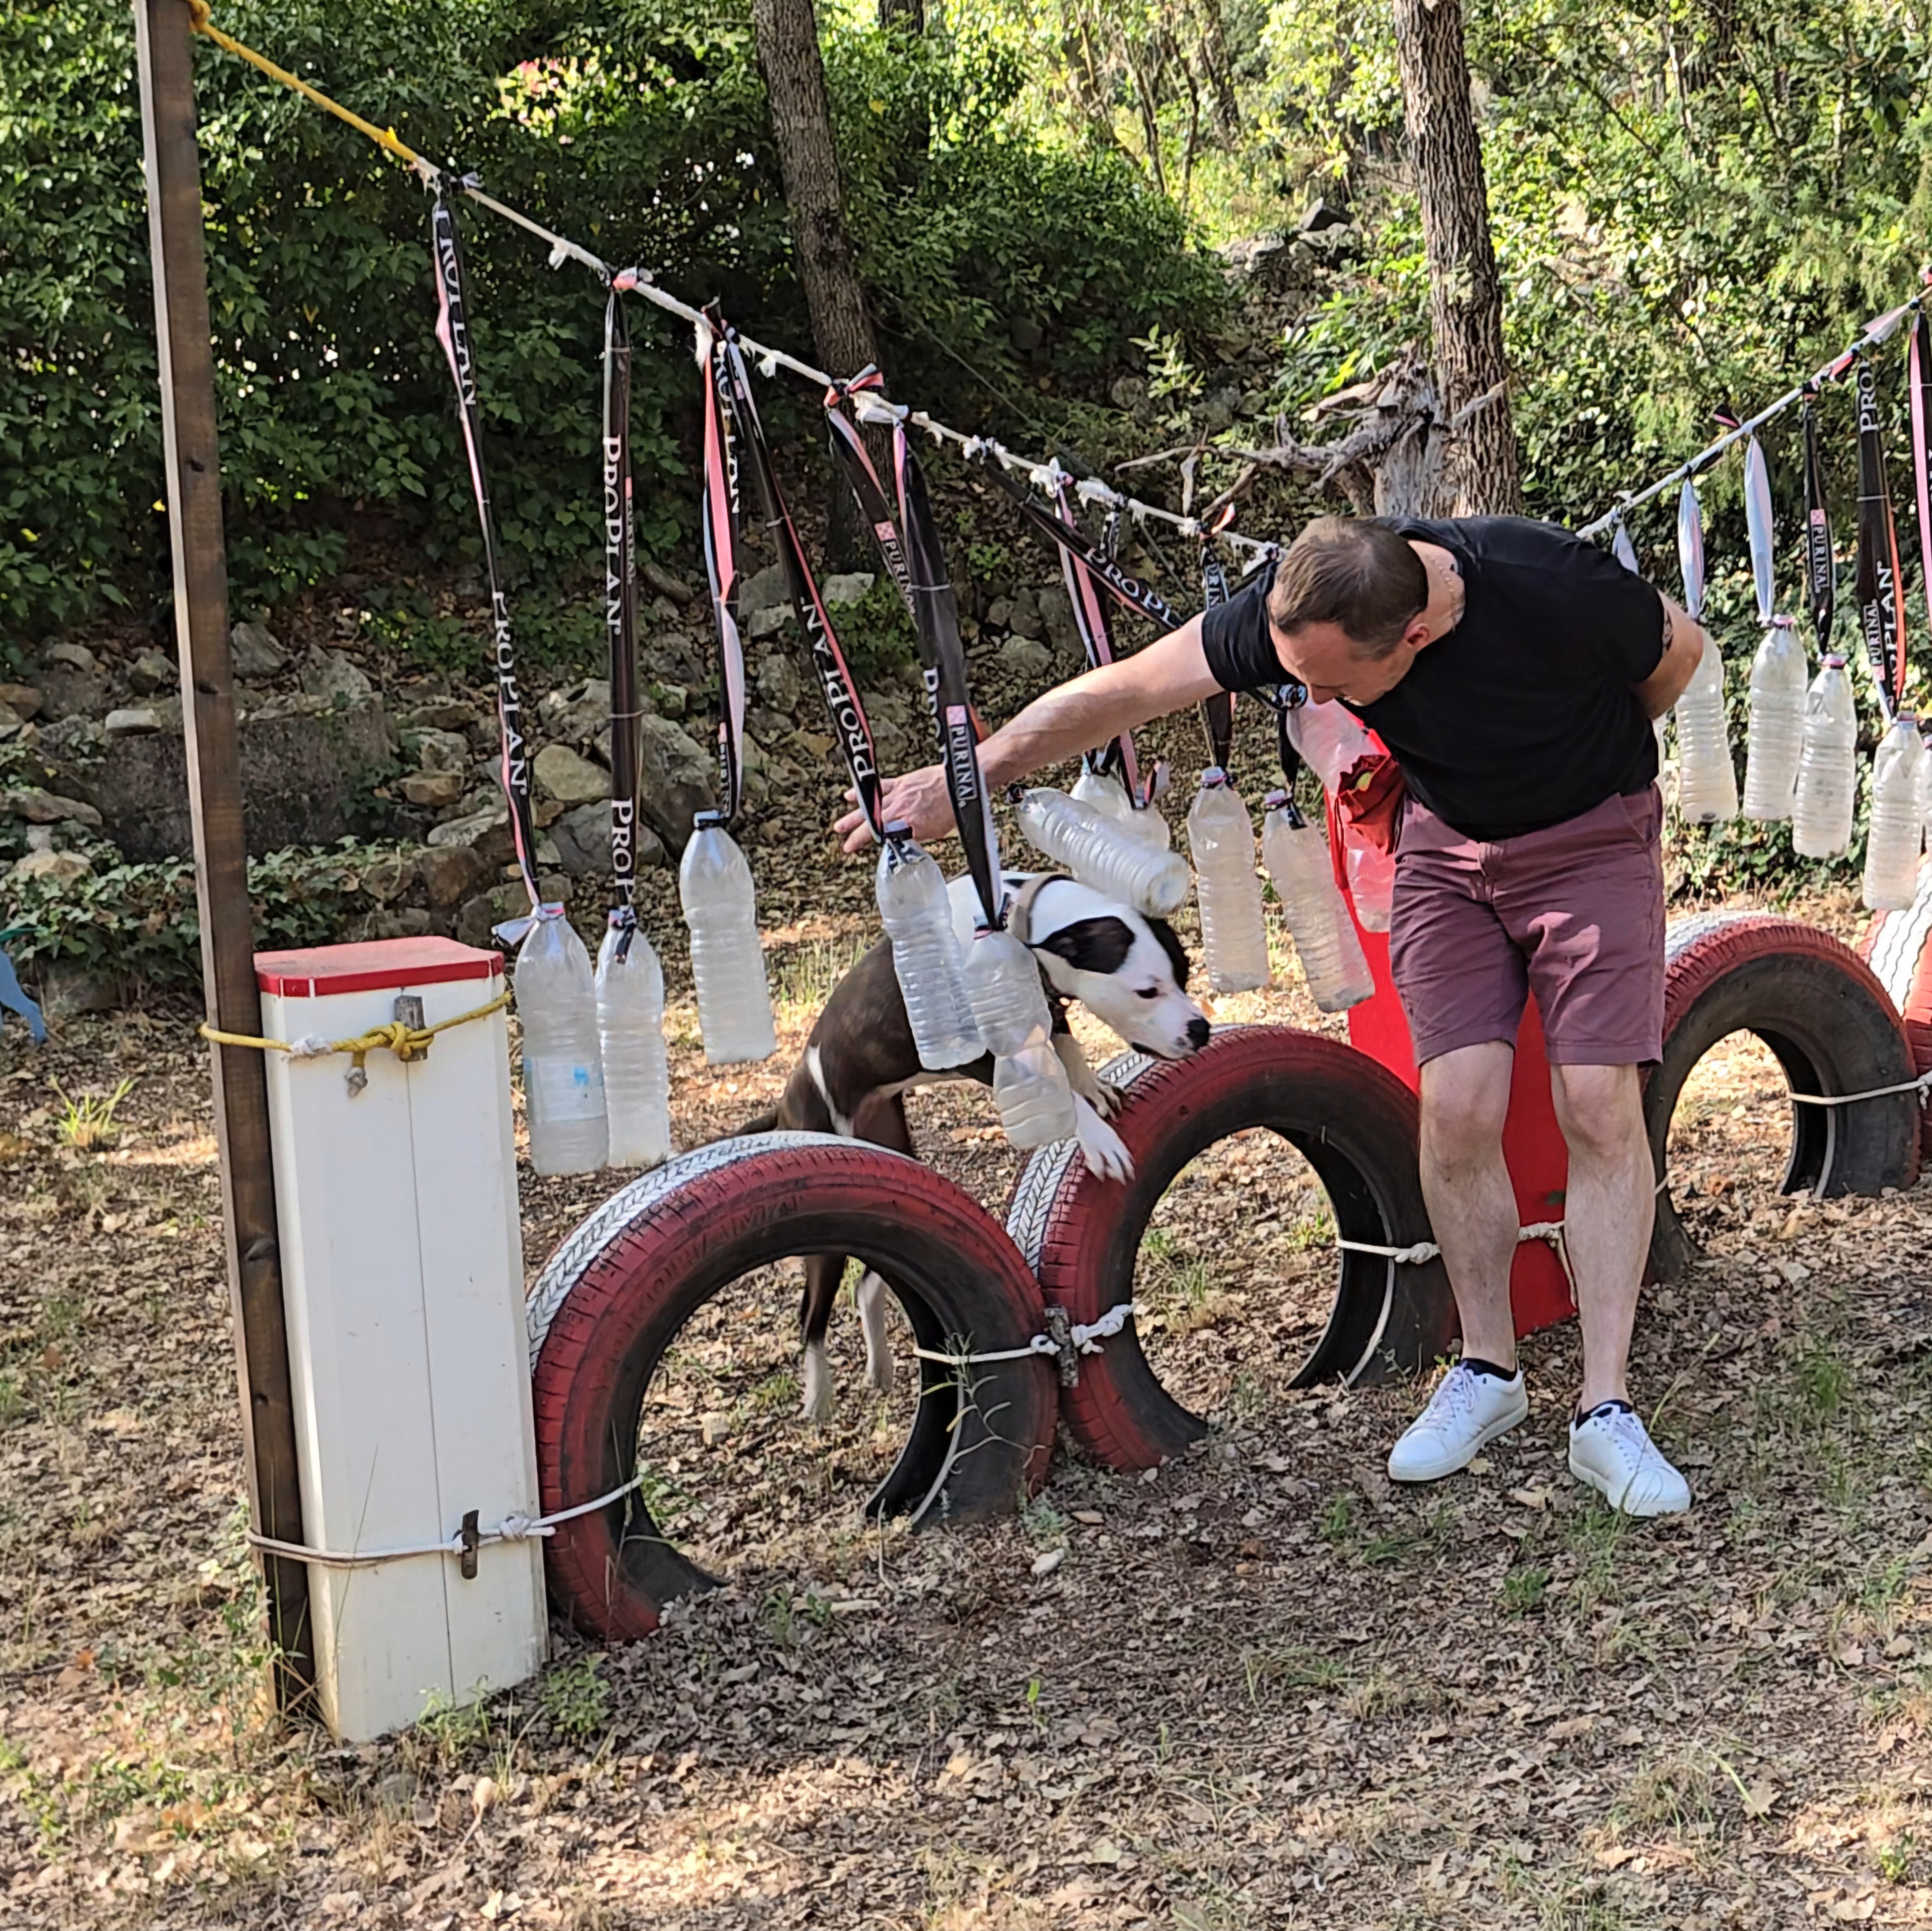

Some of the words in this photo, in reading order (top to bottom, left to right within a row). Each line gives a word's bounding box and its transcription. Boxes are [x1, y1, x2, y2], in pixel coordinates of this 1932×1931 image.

[1813, 523, 1828, 586] PURINA
[1865, 609, 1883, 665] PURINA
[951, 725, 973, 797] PURINA
